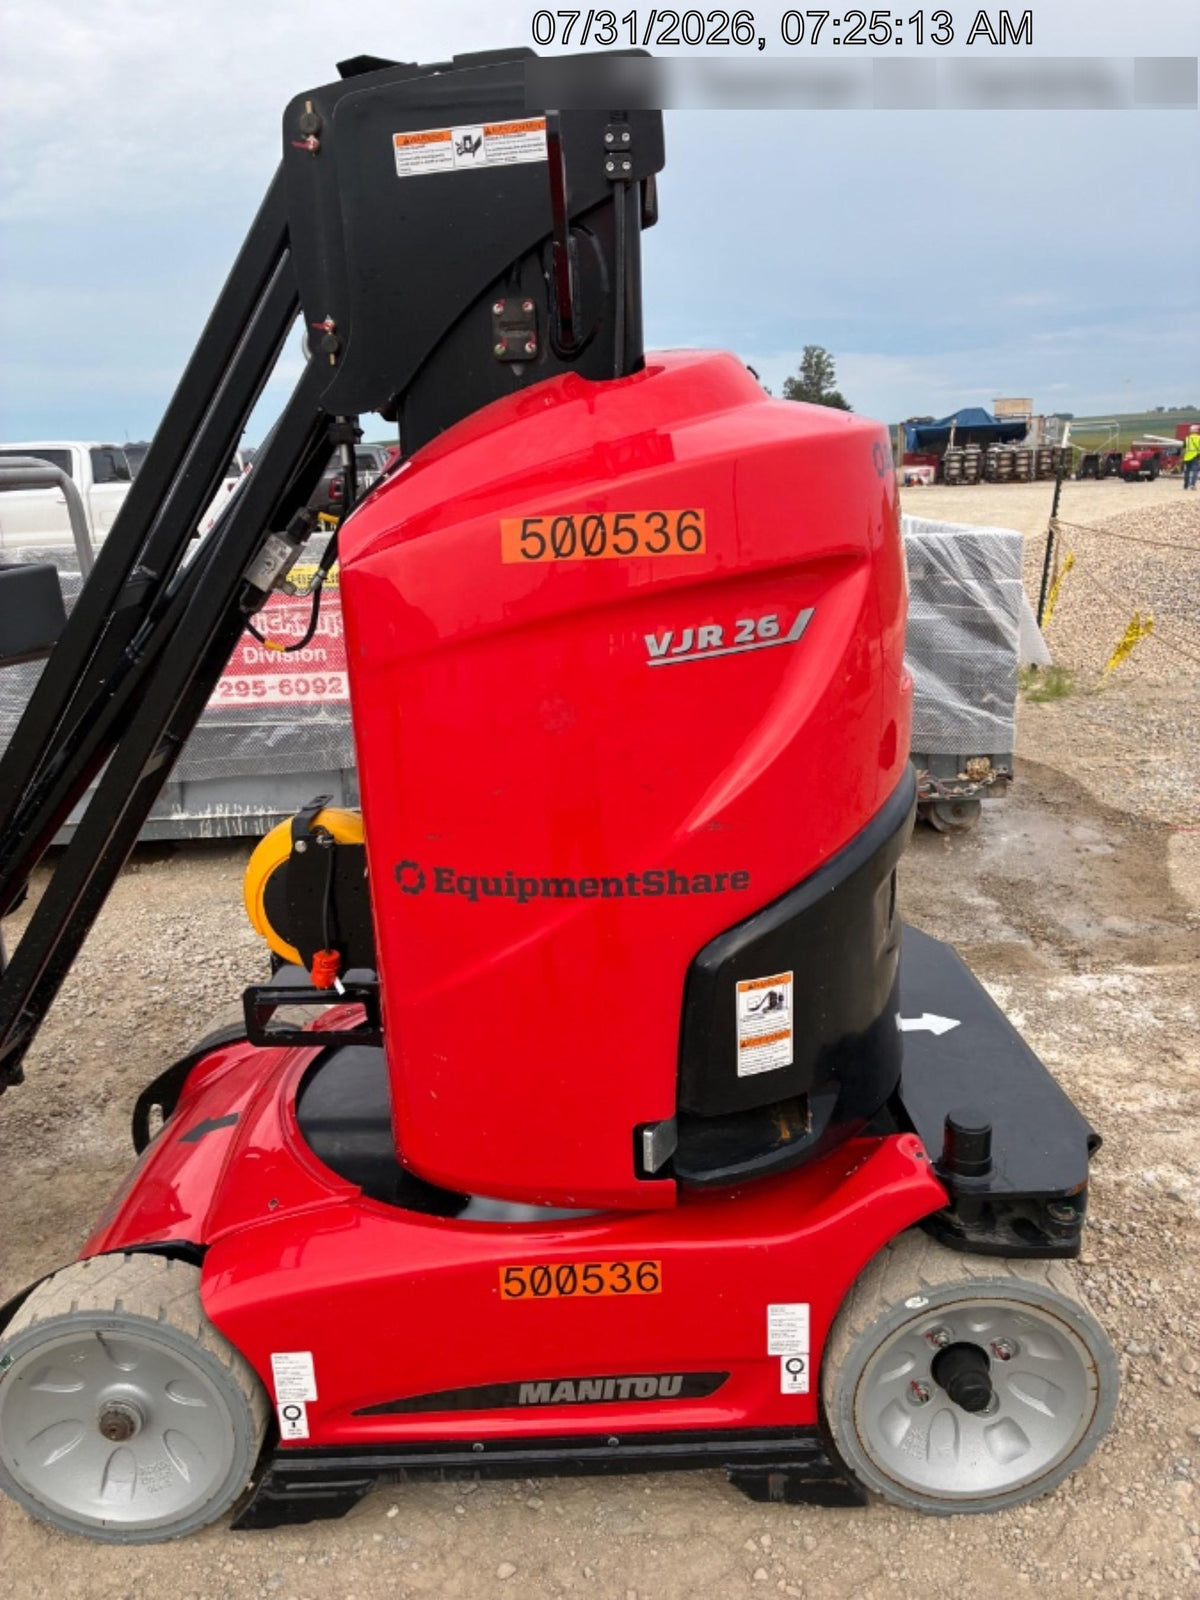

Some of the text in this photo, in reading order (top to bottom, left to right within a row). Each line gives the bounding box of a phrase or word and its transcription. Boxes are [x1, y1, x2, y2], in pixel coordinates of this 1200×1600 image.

[520, 510, 704, 559] 500536
[644, 614, 780, 657] VJR 26
[243, 645, 327, 664] Division
[219, 676, 343, 697] 295-6092
[433, 867, 750, 904] EquipmentShare
[503, 1261, 660, 1298] 500536
[518, 1375, 684, 1406] MANITOU
